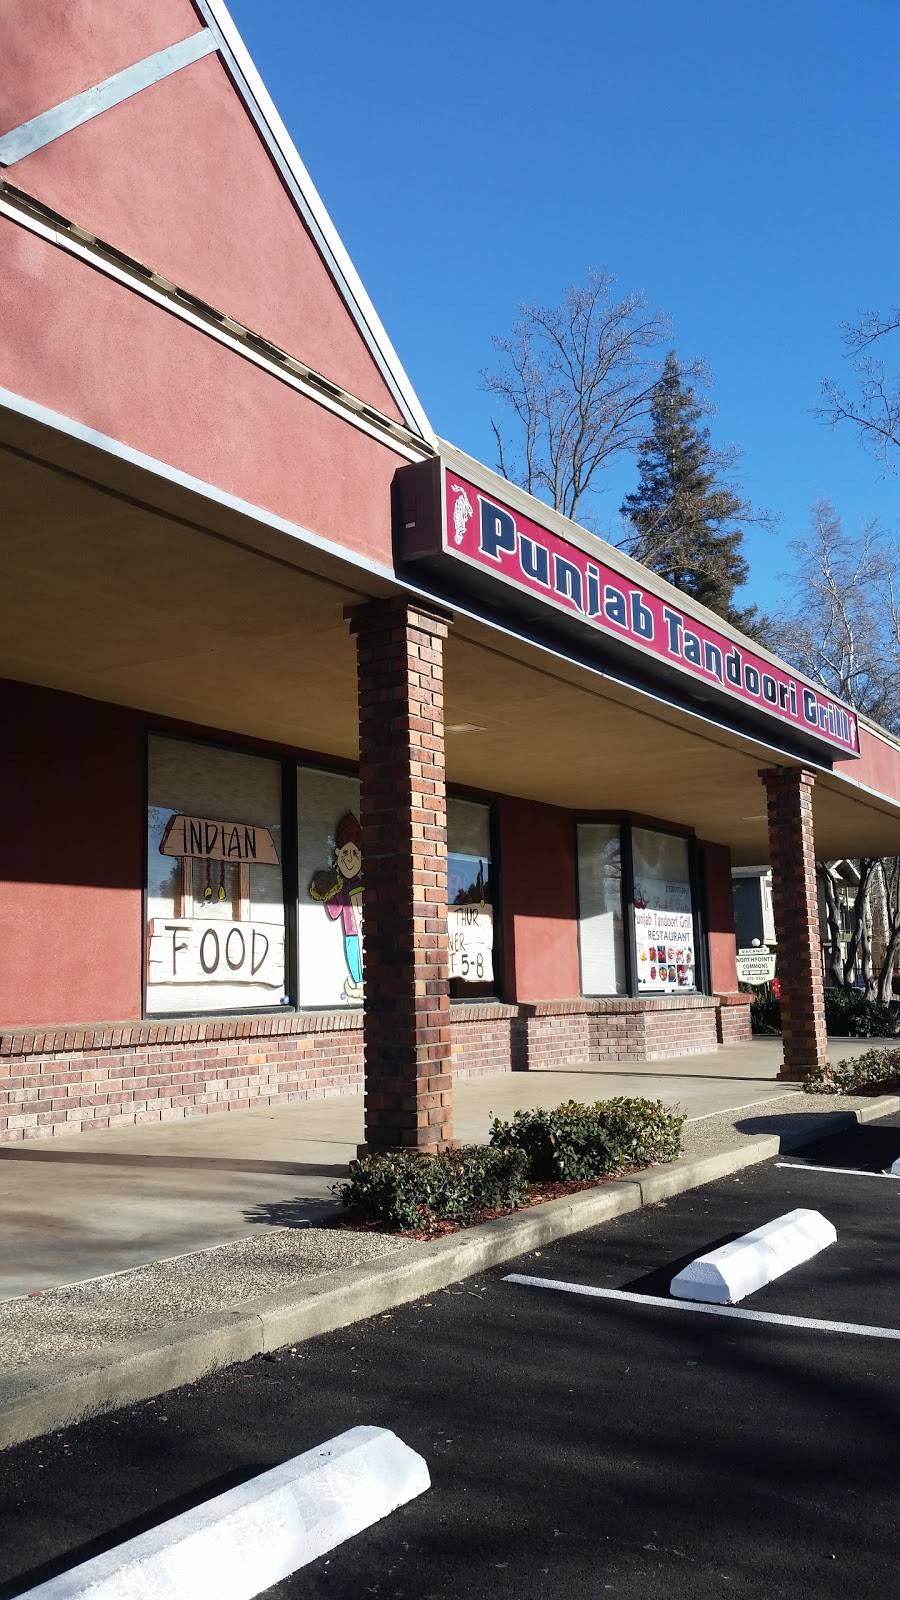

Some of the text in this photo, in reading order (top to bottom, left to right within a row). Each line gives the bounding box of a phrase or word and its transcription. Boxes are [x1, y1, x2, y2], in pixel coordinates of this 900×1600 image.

[477, 493, 851, 745] Punjab Tandoori Grill
[182, 818, 257, 859] INDIAN
[637, 912, 692, 929] unjab Tandoori Grill
[648, 930, 691, 942] RESTAURANT
[164, 926, 269, 976] FOOD
